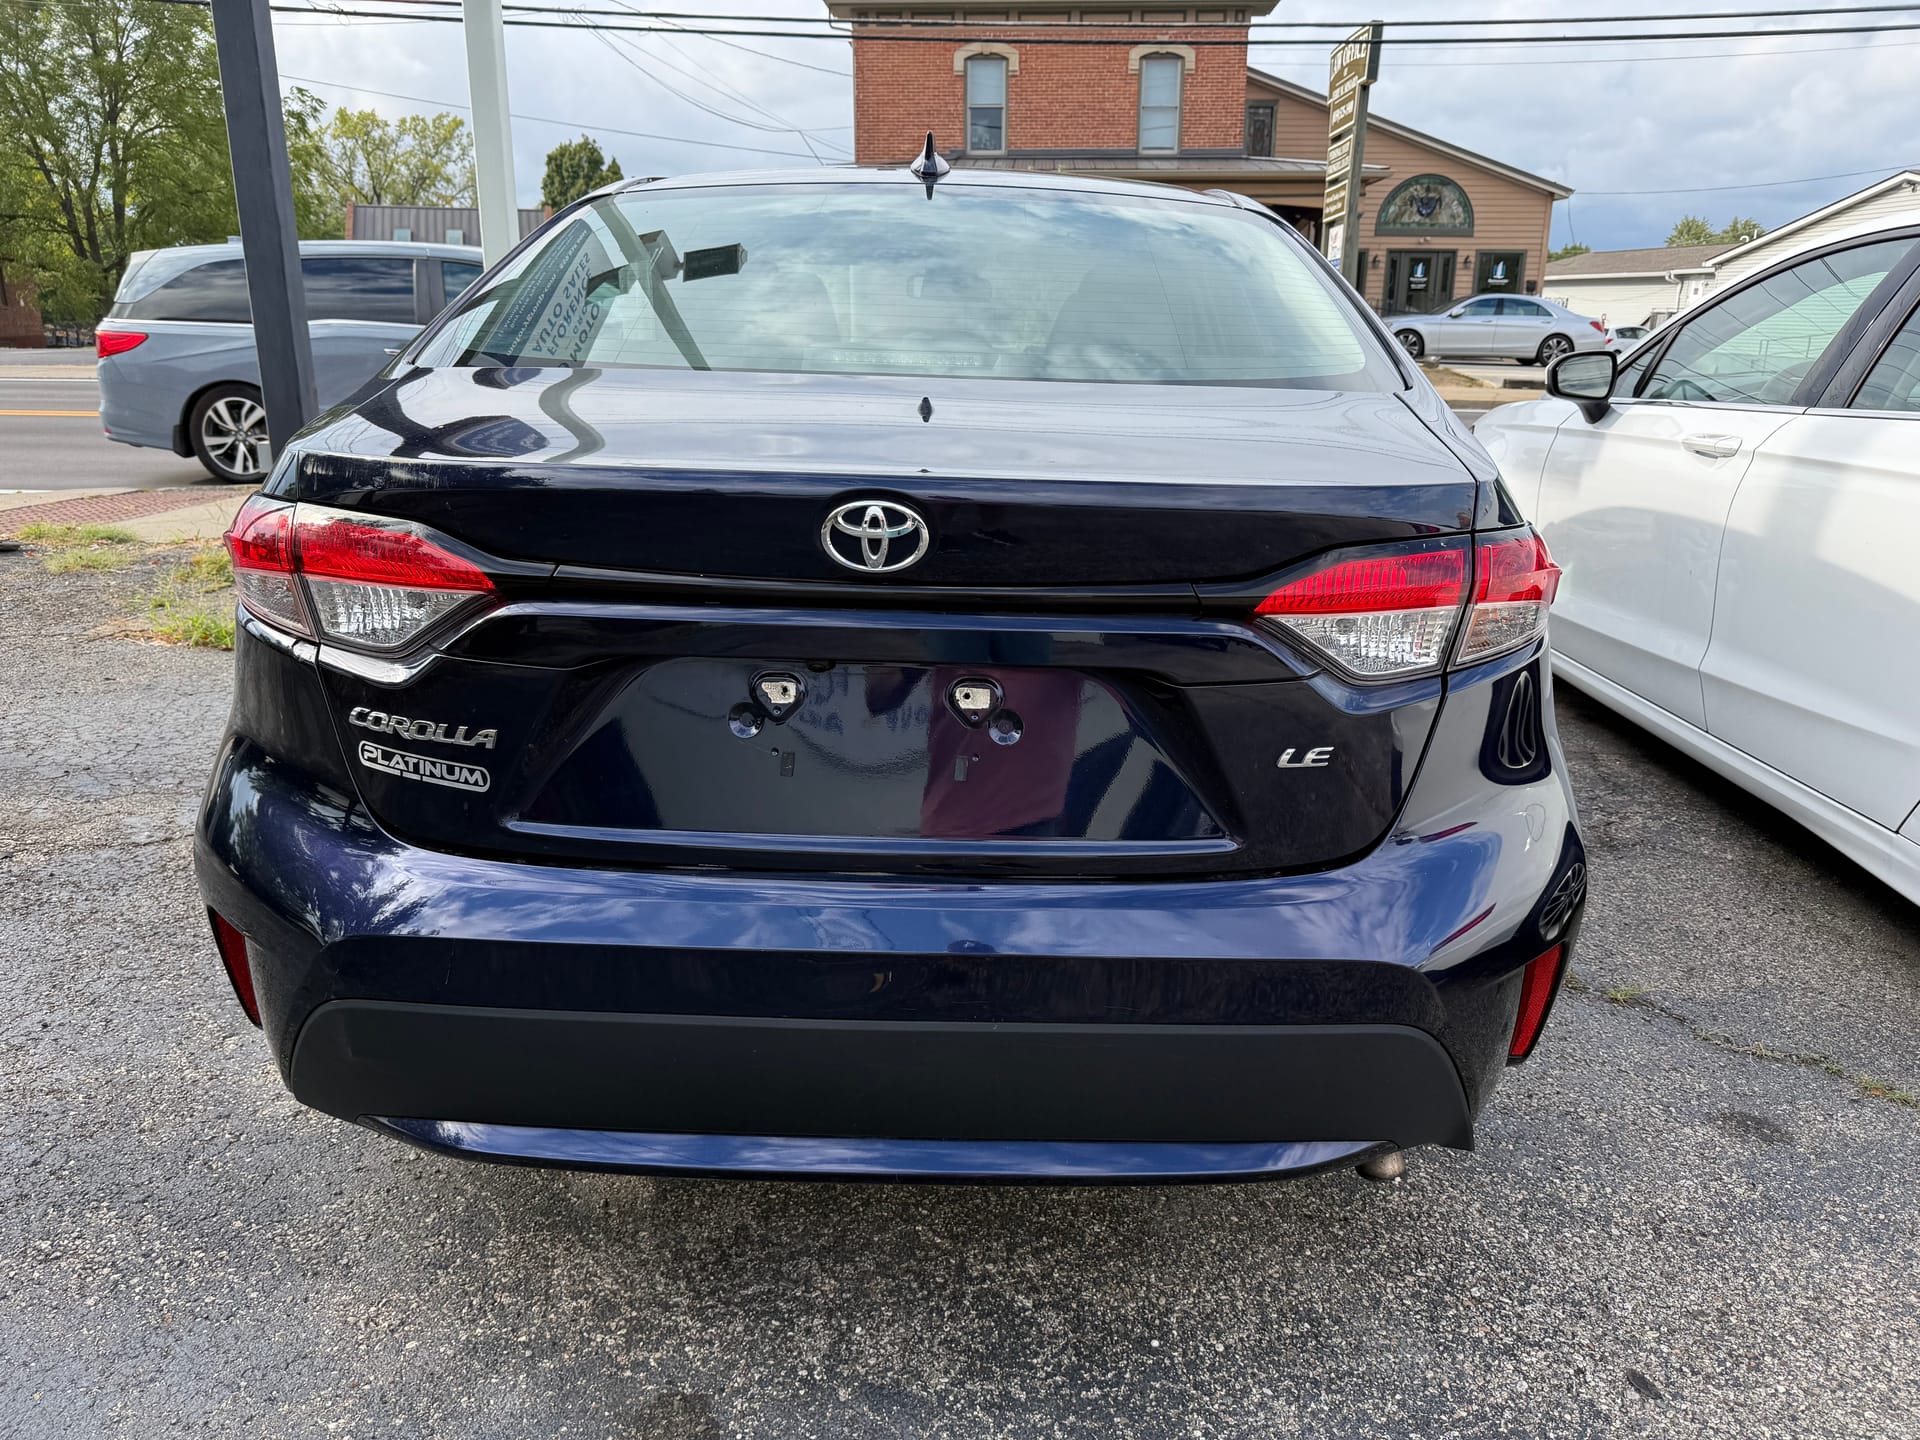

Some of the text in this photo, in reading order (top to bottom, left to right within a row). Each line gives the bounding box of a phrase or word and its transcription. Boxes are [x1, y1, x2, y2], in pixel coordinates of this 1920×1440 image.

[1330, 50, 1343, 81] LAW
[348, 706, 499, 750] COROLLA
[362, 745, 486, 787] PLATINUM
[1276, 746, 1335, 768] LE
